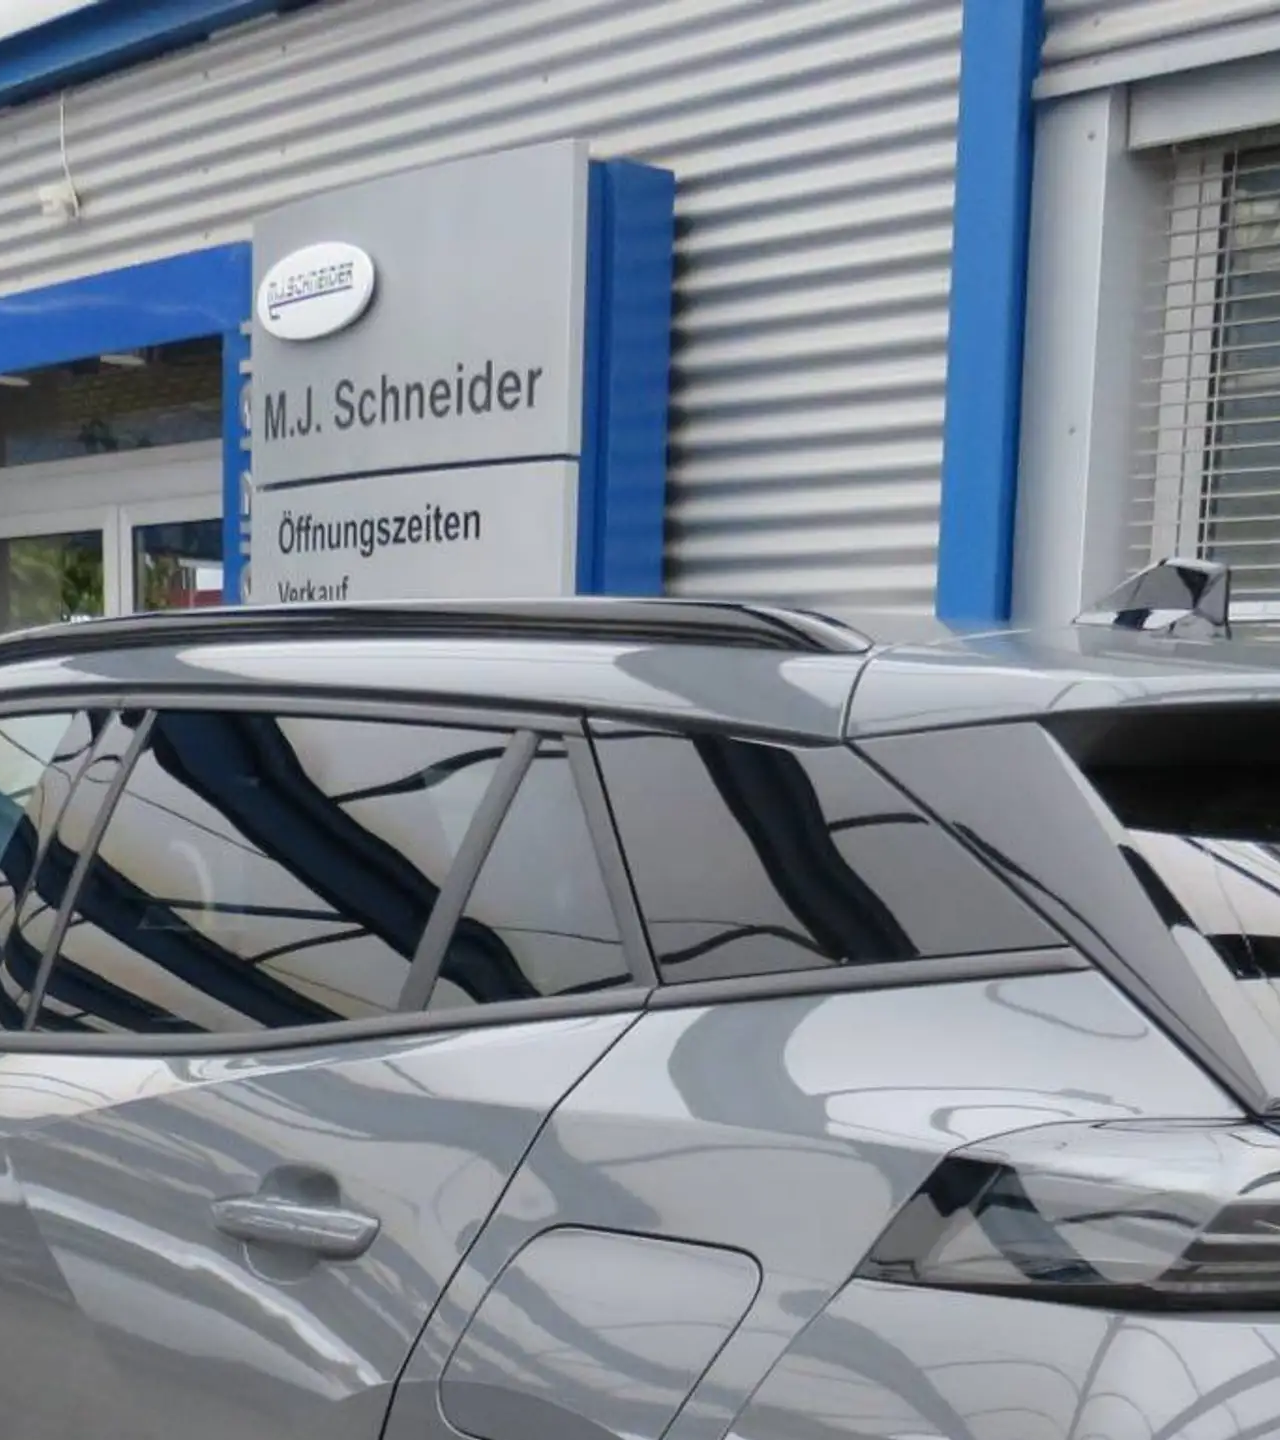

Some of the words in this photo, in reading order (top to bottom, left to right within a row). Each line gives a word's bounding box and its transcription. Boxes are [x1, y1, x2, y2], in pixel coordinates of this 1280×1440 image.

[264, 384, 322, 442] M.J.
[333, 359, 543, 430] Schneider
[277, 502, 481, 558] Öffnungszeiten
[277, 575, 349, 603] Verkauf
